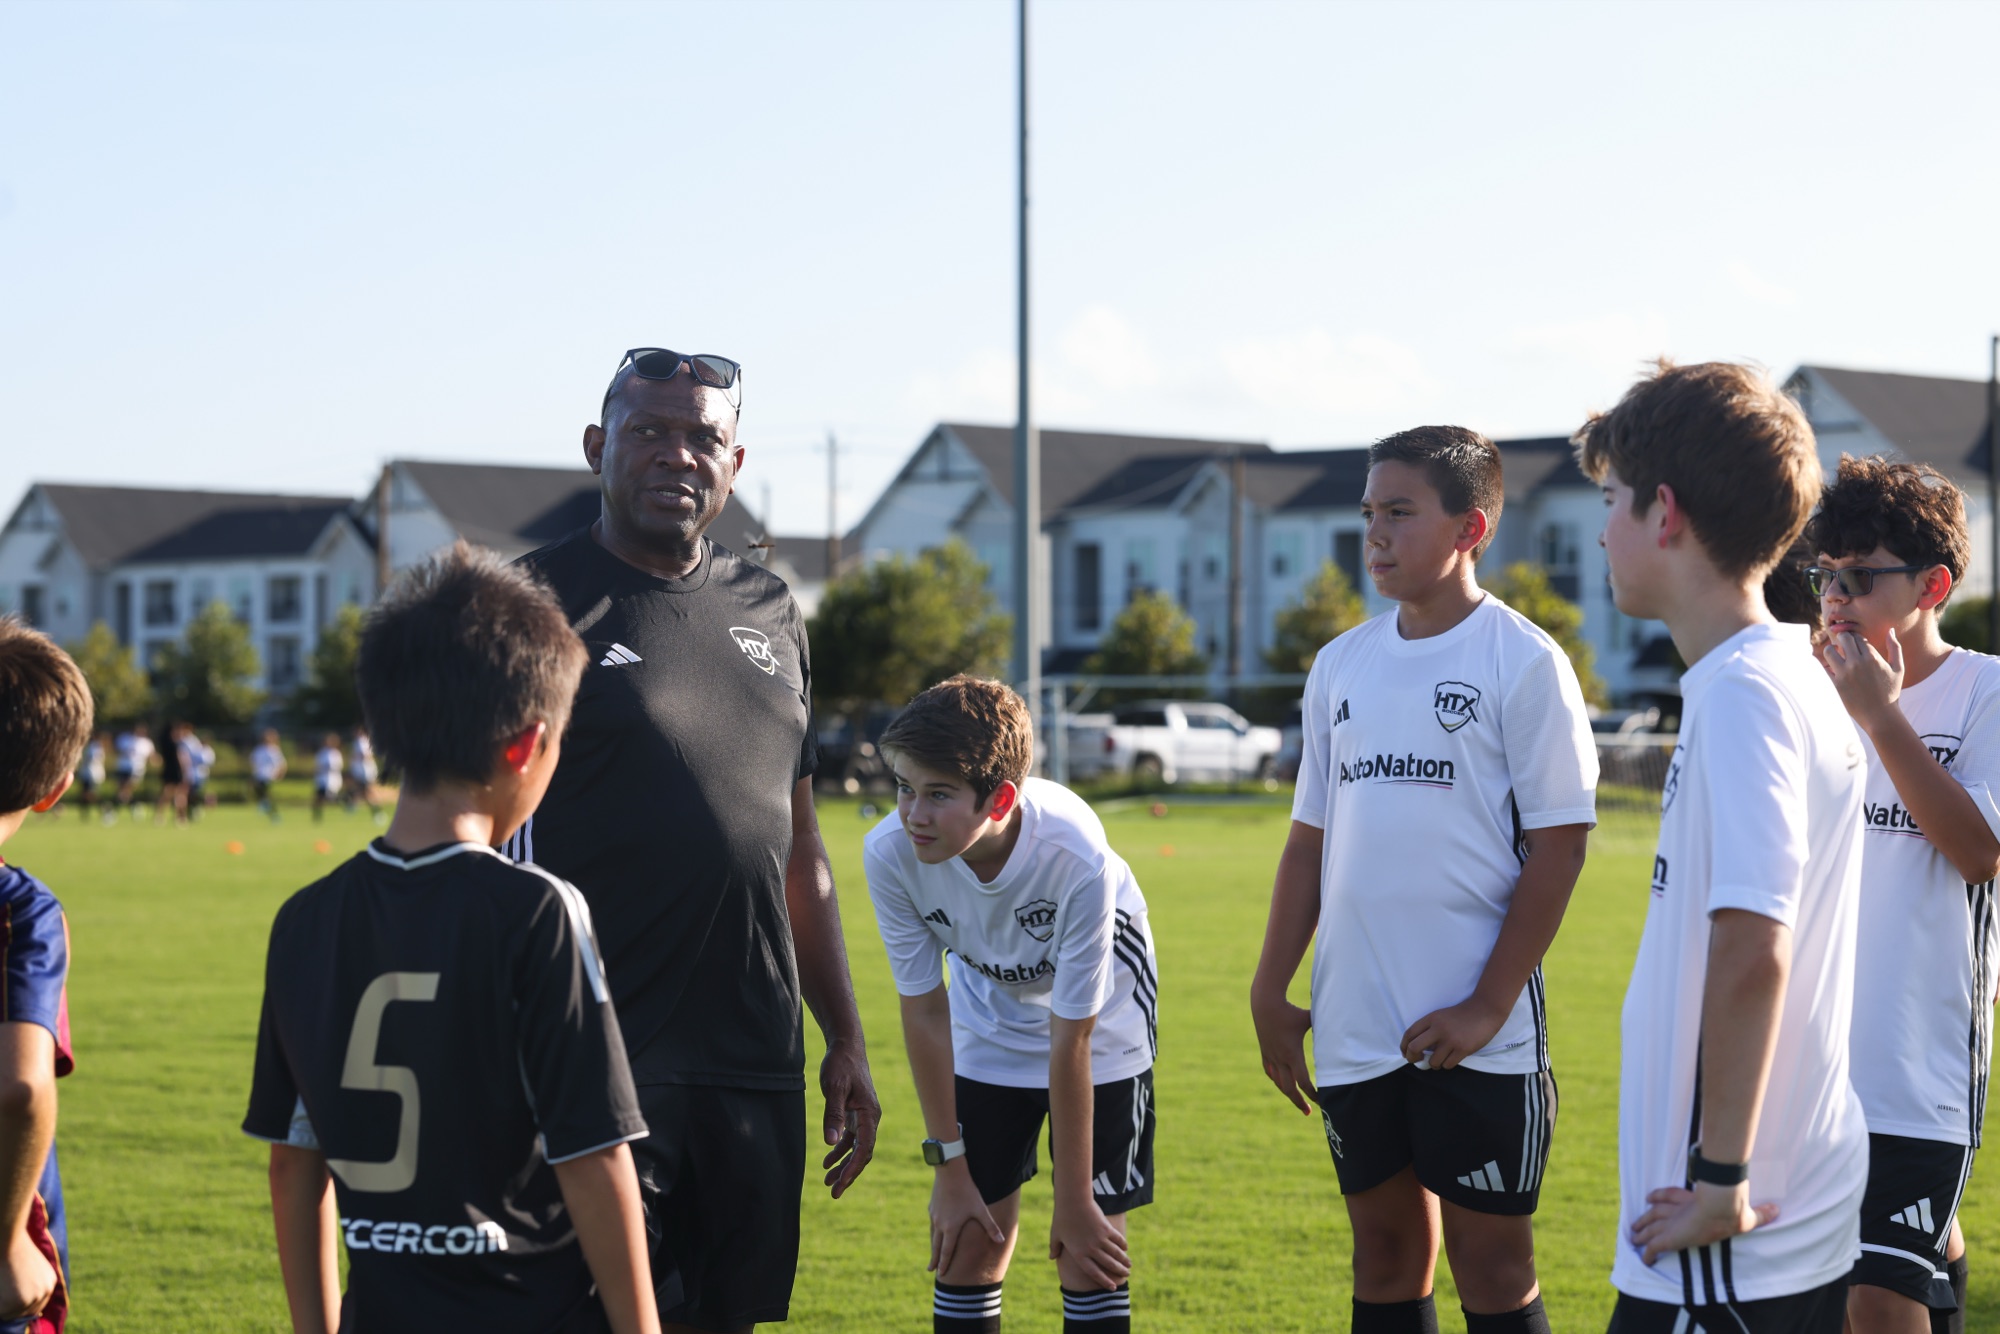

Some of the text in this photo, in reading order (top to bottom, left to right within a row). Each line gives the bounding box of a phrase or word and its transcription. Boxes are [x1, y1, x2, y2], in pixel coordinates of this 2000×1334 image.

[736, 637, 781, 666] HTX
[1434, 691, 1478, 723] HTX
[1340, 753, 1455, 787] AutoNation
[1929, 746, 1959, 765] TX
[1019, 909, 1057, 928] HTX
[327, 972, 440, 1192] 5
[340, 1218, 508, 1254] CER.COM
